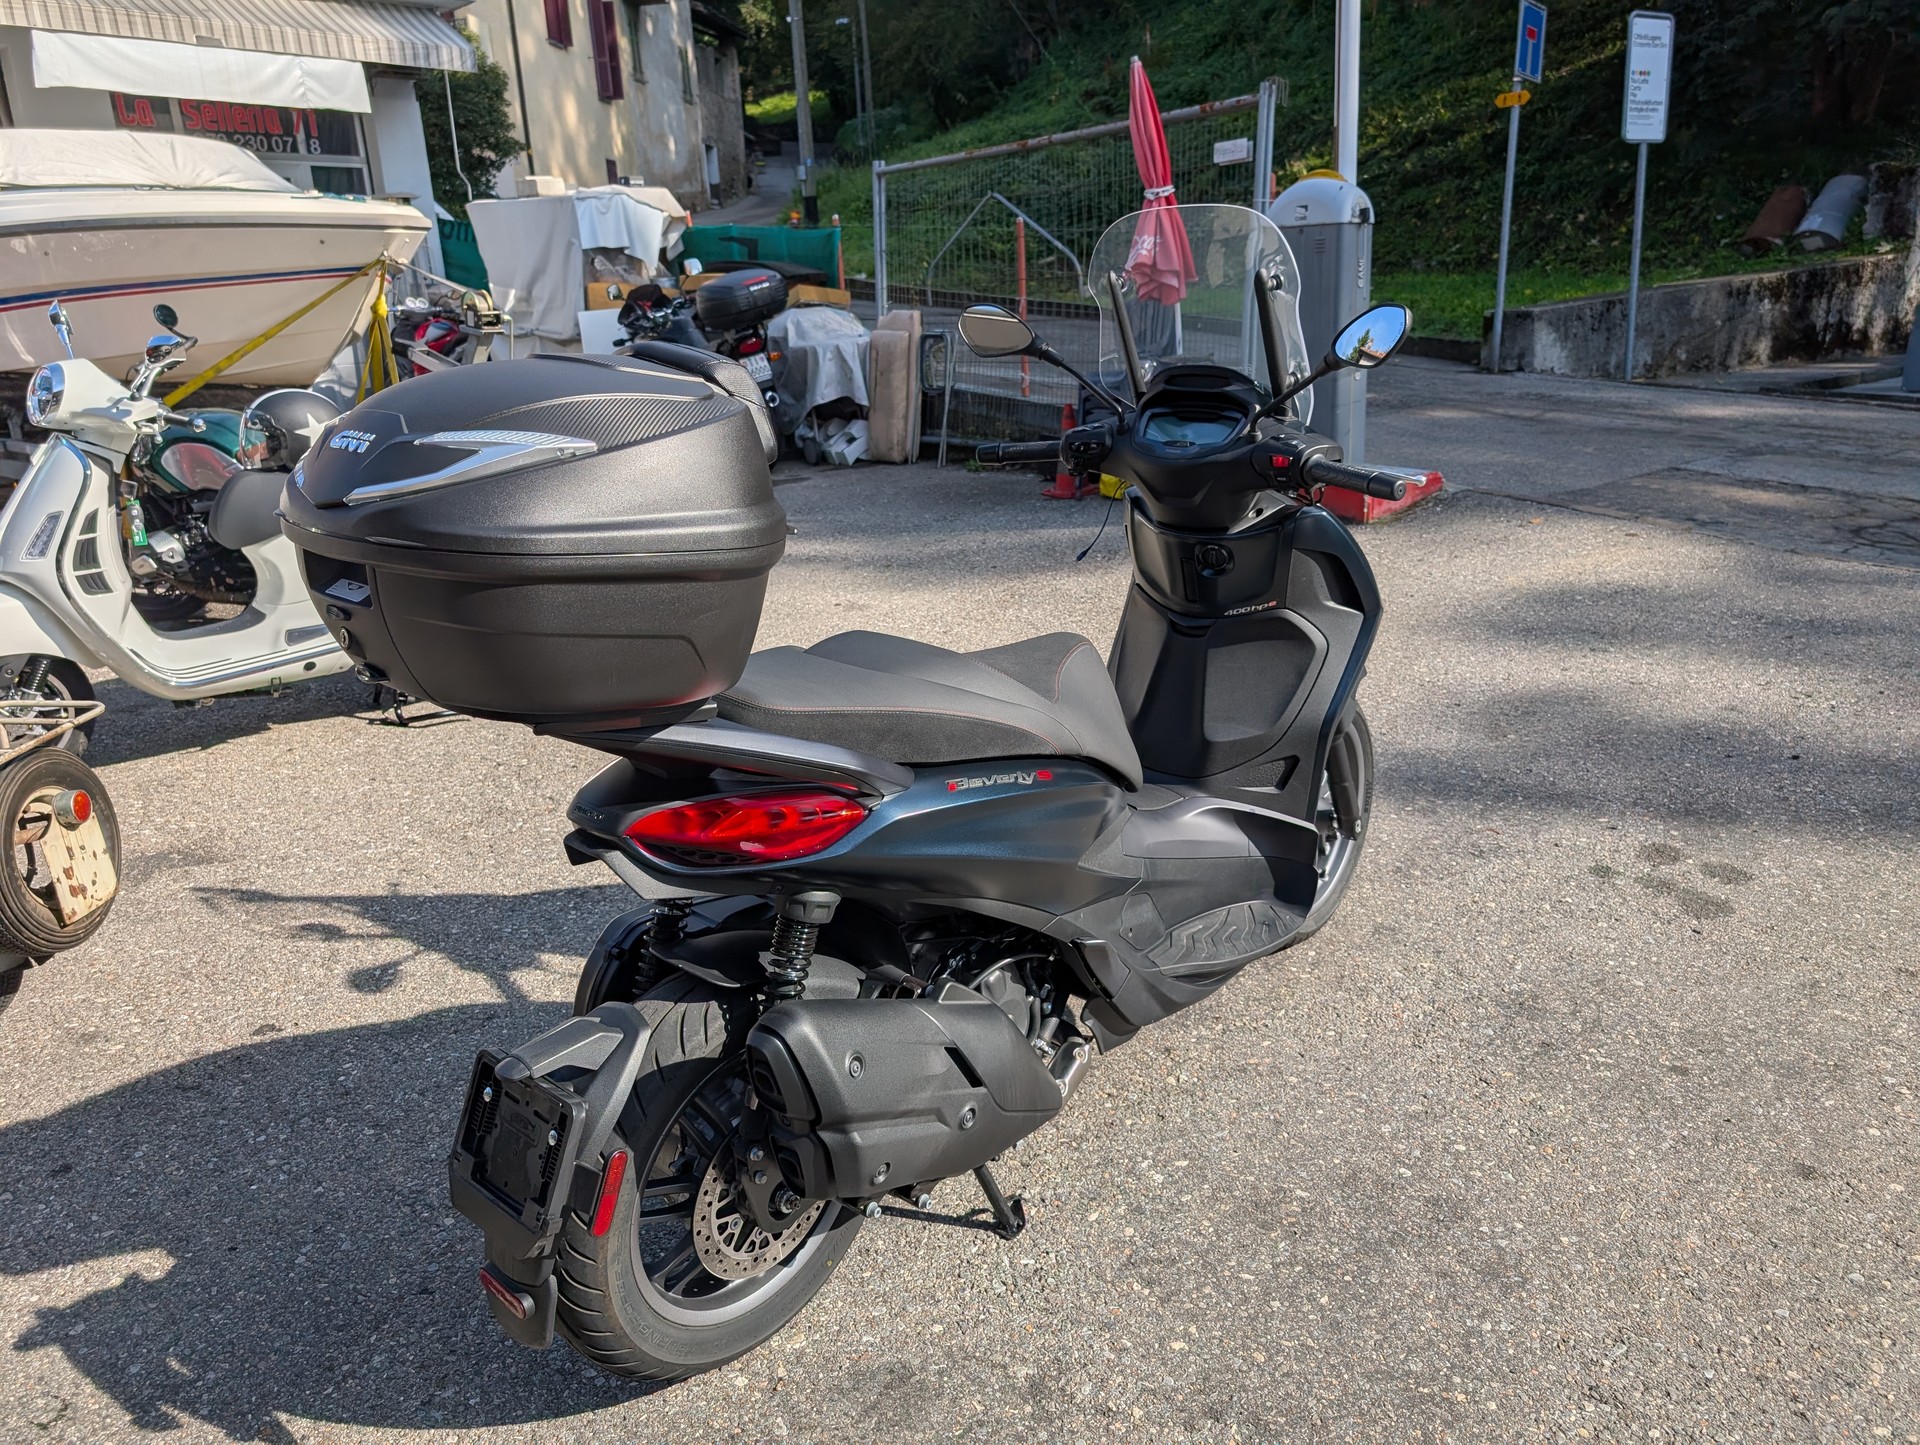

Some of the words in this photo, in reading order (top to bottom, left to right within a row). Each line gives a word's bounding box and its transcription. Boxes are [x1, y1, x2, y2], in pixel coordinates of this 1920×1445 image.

[114, 92, 157, 127] La
[180, 99, 283, 135] Selleria
[271, 136, 294, 153] 07
[329, 429, 377, 454] GIVI
